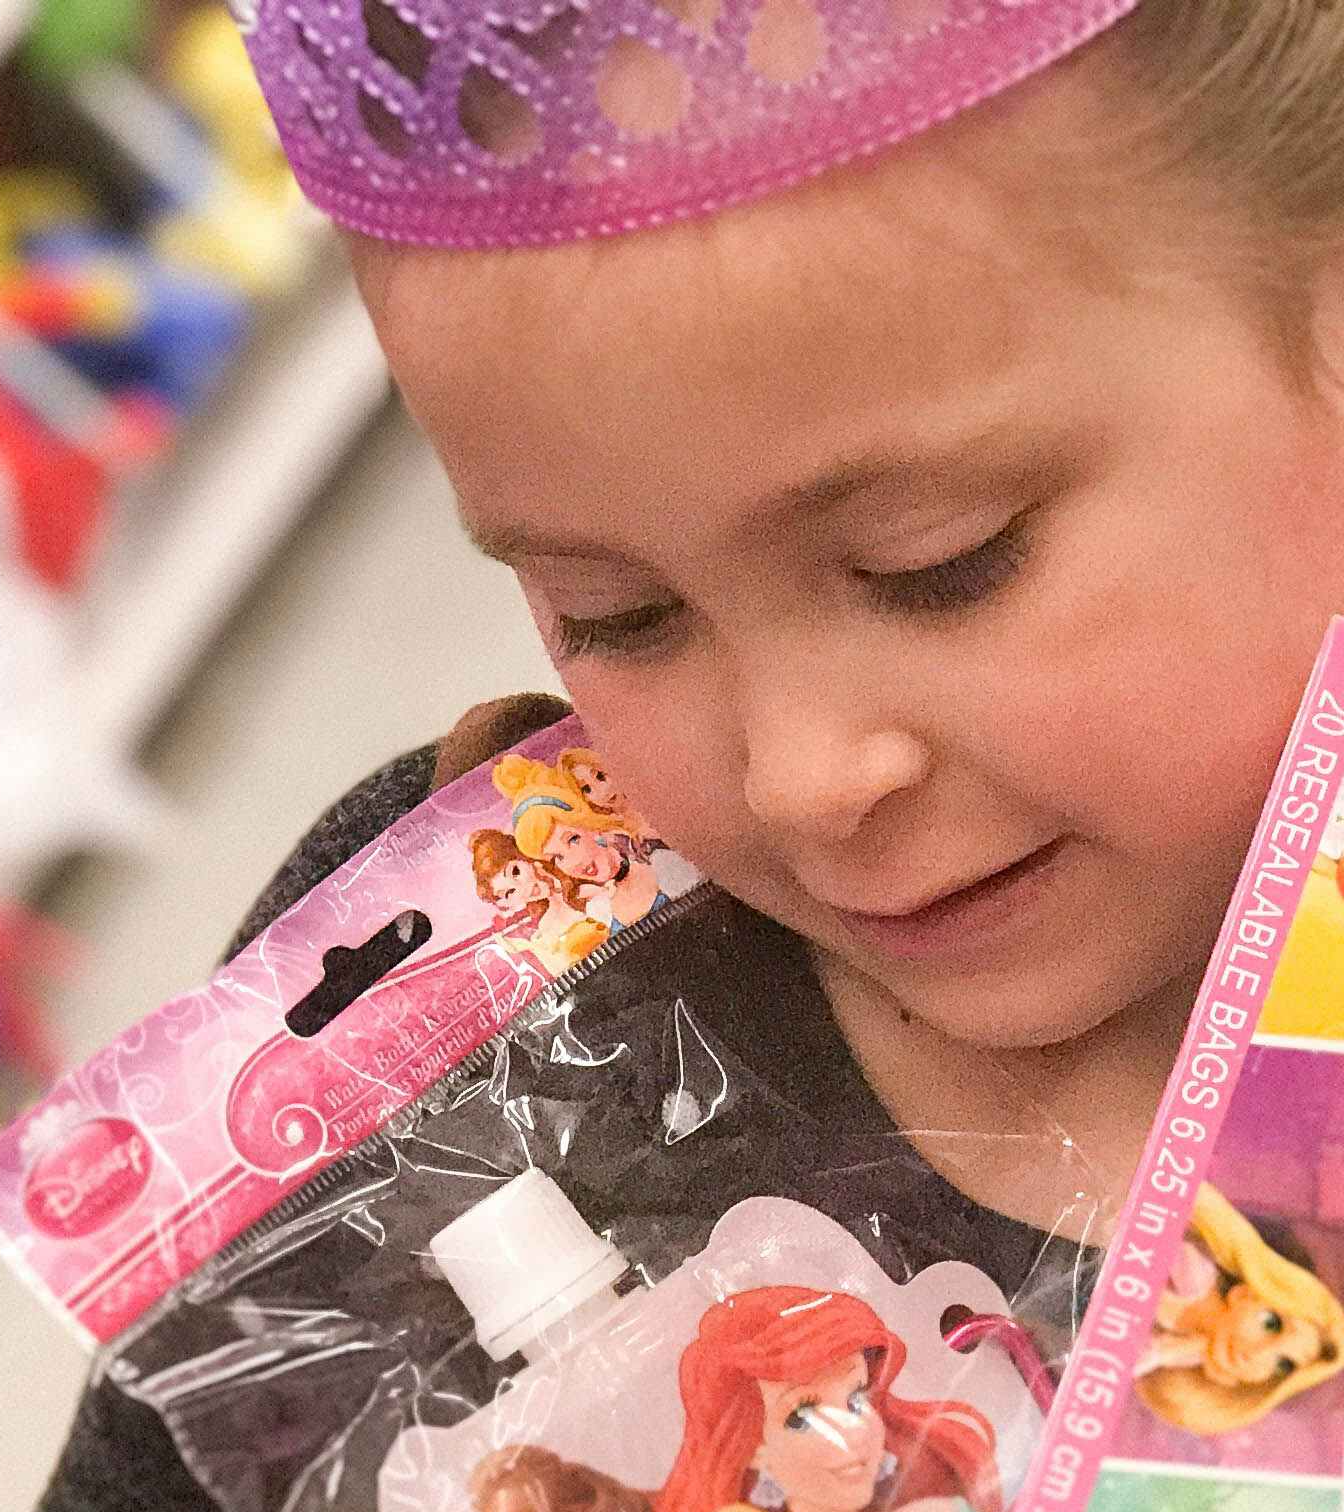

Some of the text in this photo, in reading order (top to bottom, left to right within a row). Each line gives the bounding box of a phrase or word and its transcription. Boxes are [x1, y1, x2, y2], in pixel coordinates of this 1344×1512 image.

[1219, 743, 1338, 997] RESEALABLE
[1181, 1001, 1249, 1110] BAGS
[1150, 1116, 1207, 1198] 6.25
[1134, 1201, 1179, 1236] in
[1122, 1242, 1155, 1269] x
[1113, 1274, 1153, 1302] 6
[1097, 1306, 1142, 1342] in
[1063, 1349, 1126, 1441] (15.9
[1039, 1444, 1084, 1502] cm
